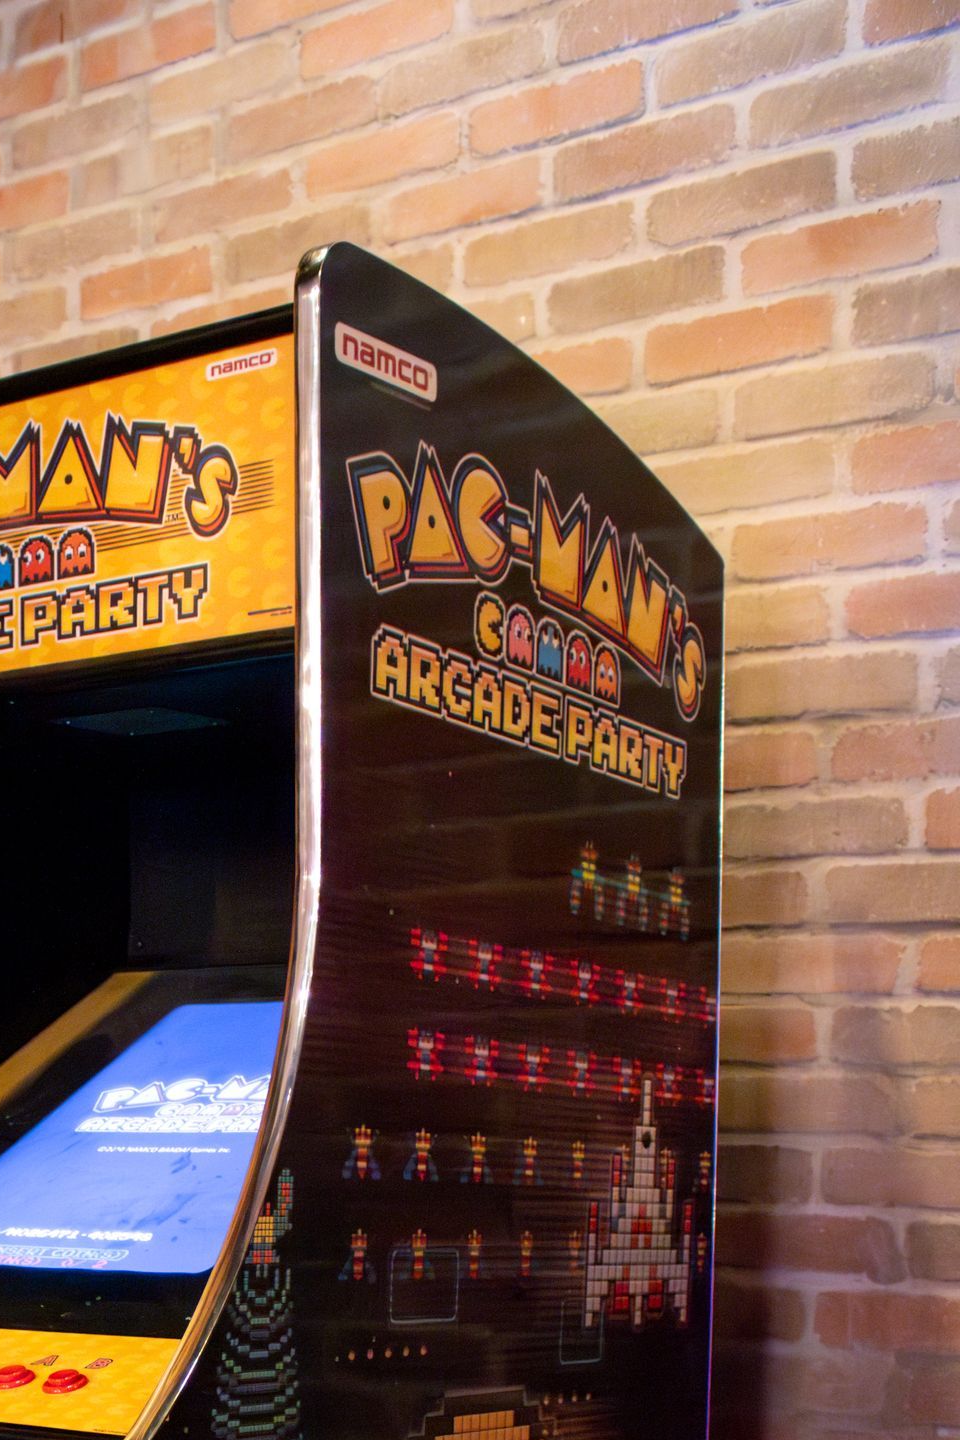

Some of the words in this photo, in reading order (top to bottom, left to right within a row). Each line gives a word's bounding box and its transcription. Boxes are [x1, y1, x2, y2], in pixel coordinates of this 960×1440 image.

[210, 351, 272, 377] namco
[342, 332, 429, 392] namco
[19, 562, 209, 648] PARTY
[346, 440, 706, 721] PAC-MAN'S
[371, 623, 562, 758] ARCADE
[564, 695, 688, 800] PARTY
